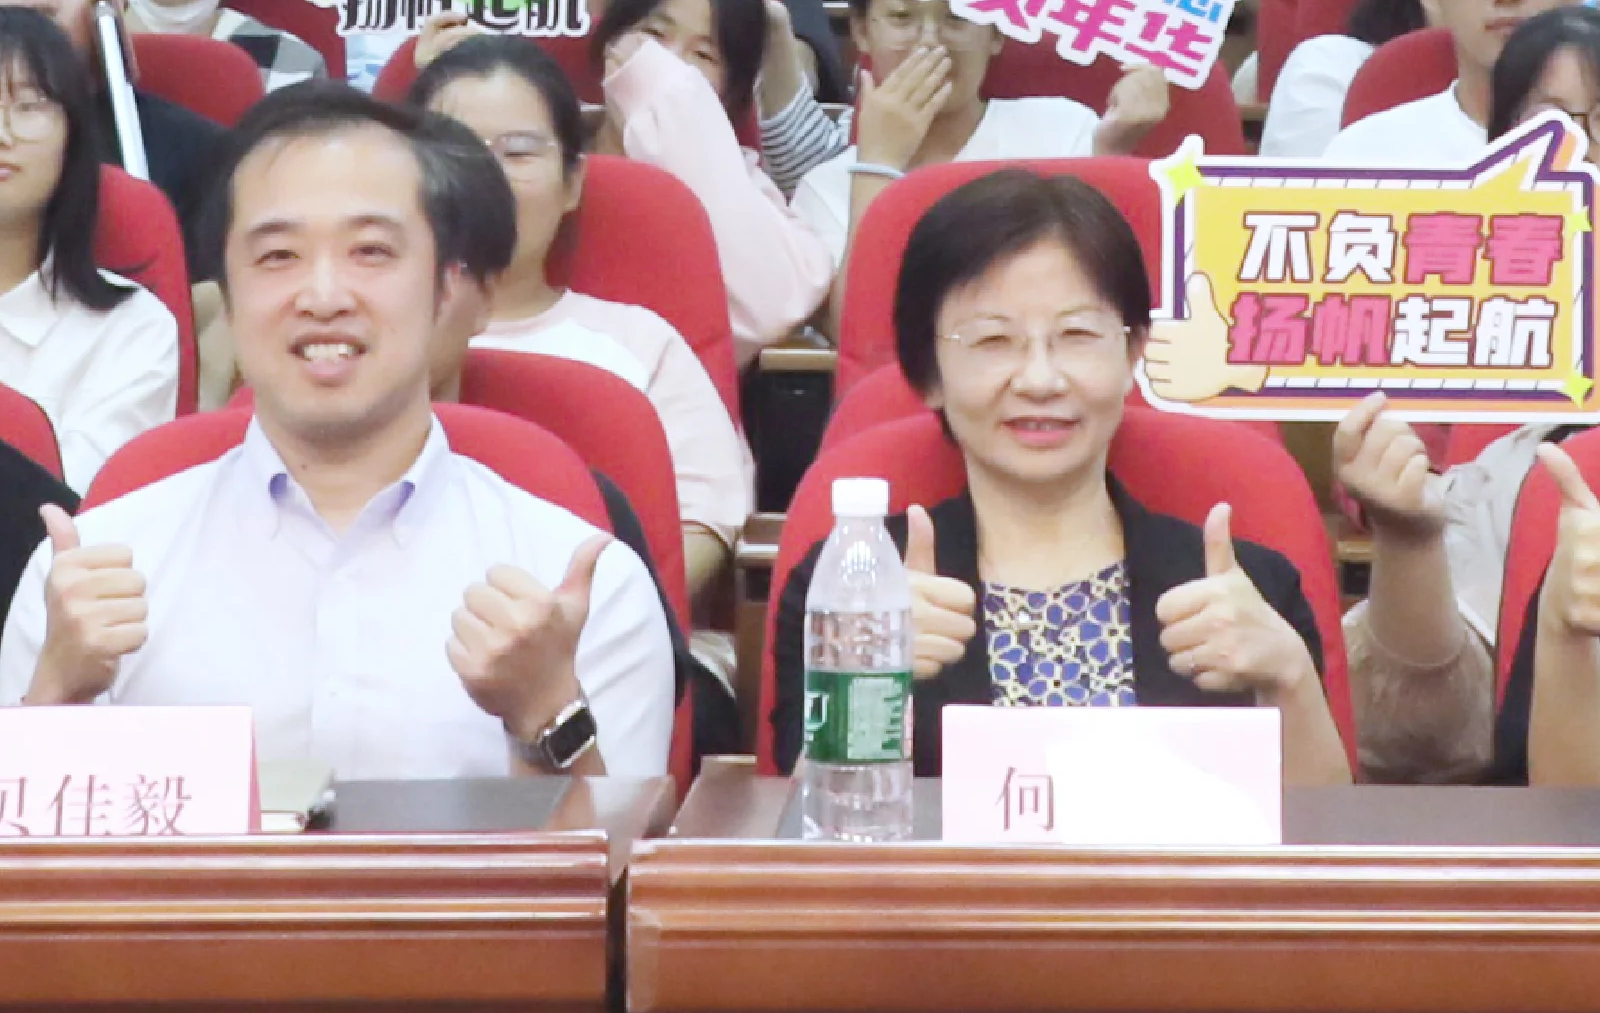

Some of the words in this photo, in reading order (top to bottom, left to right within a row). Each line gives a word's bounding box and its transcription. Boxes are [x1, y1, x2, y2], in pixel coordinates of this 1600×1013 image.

[1240, 211, 1564, 285] 不负青春
[1227, 292, 1555, 368] 扬帆起航
[997, 767, 1056, 833] 何
